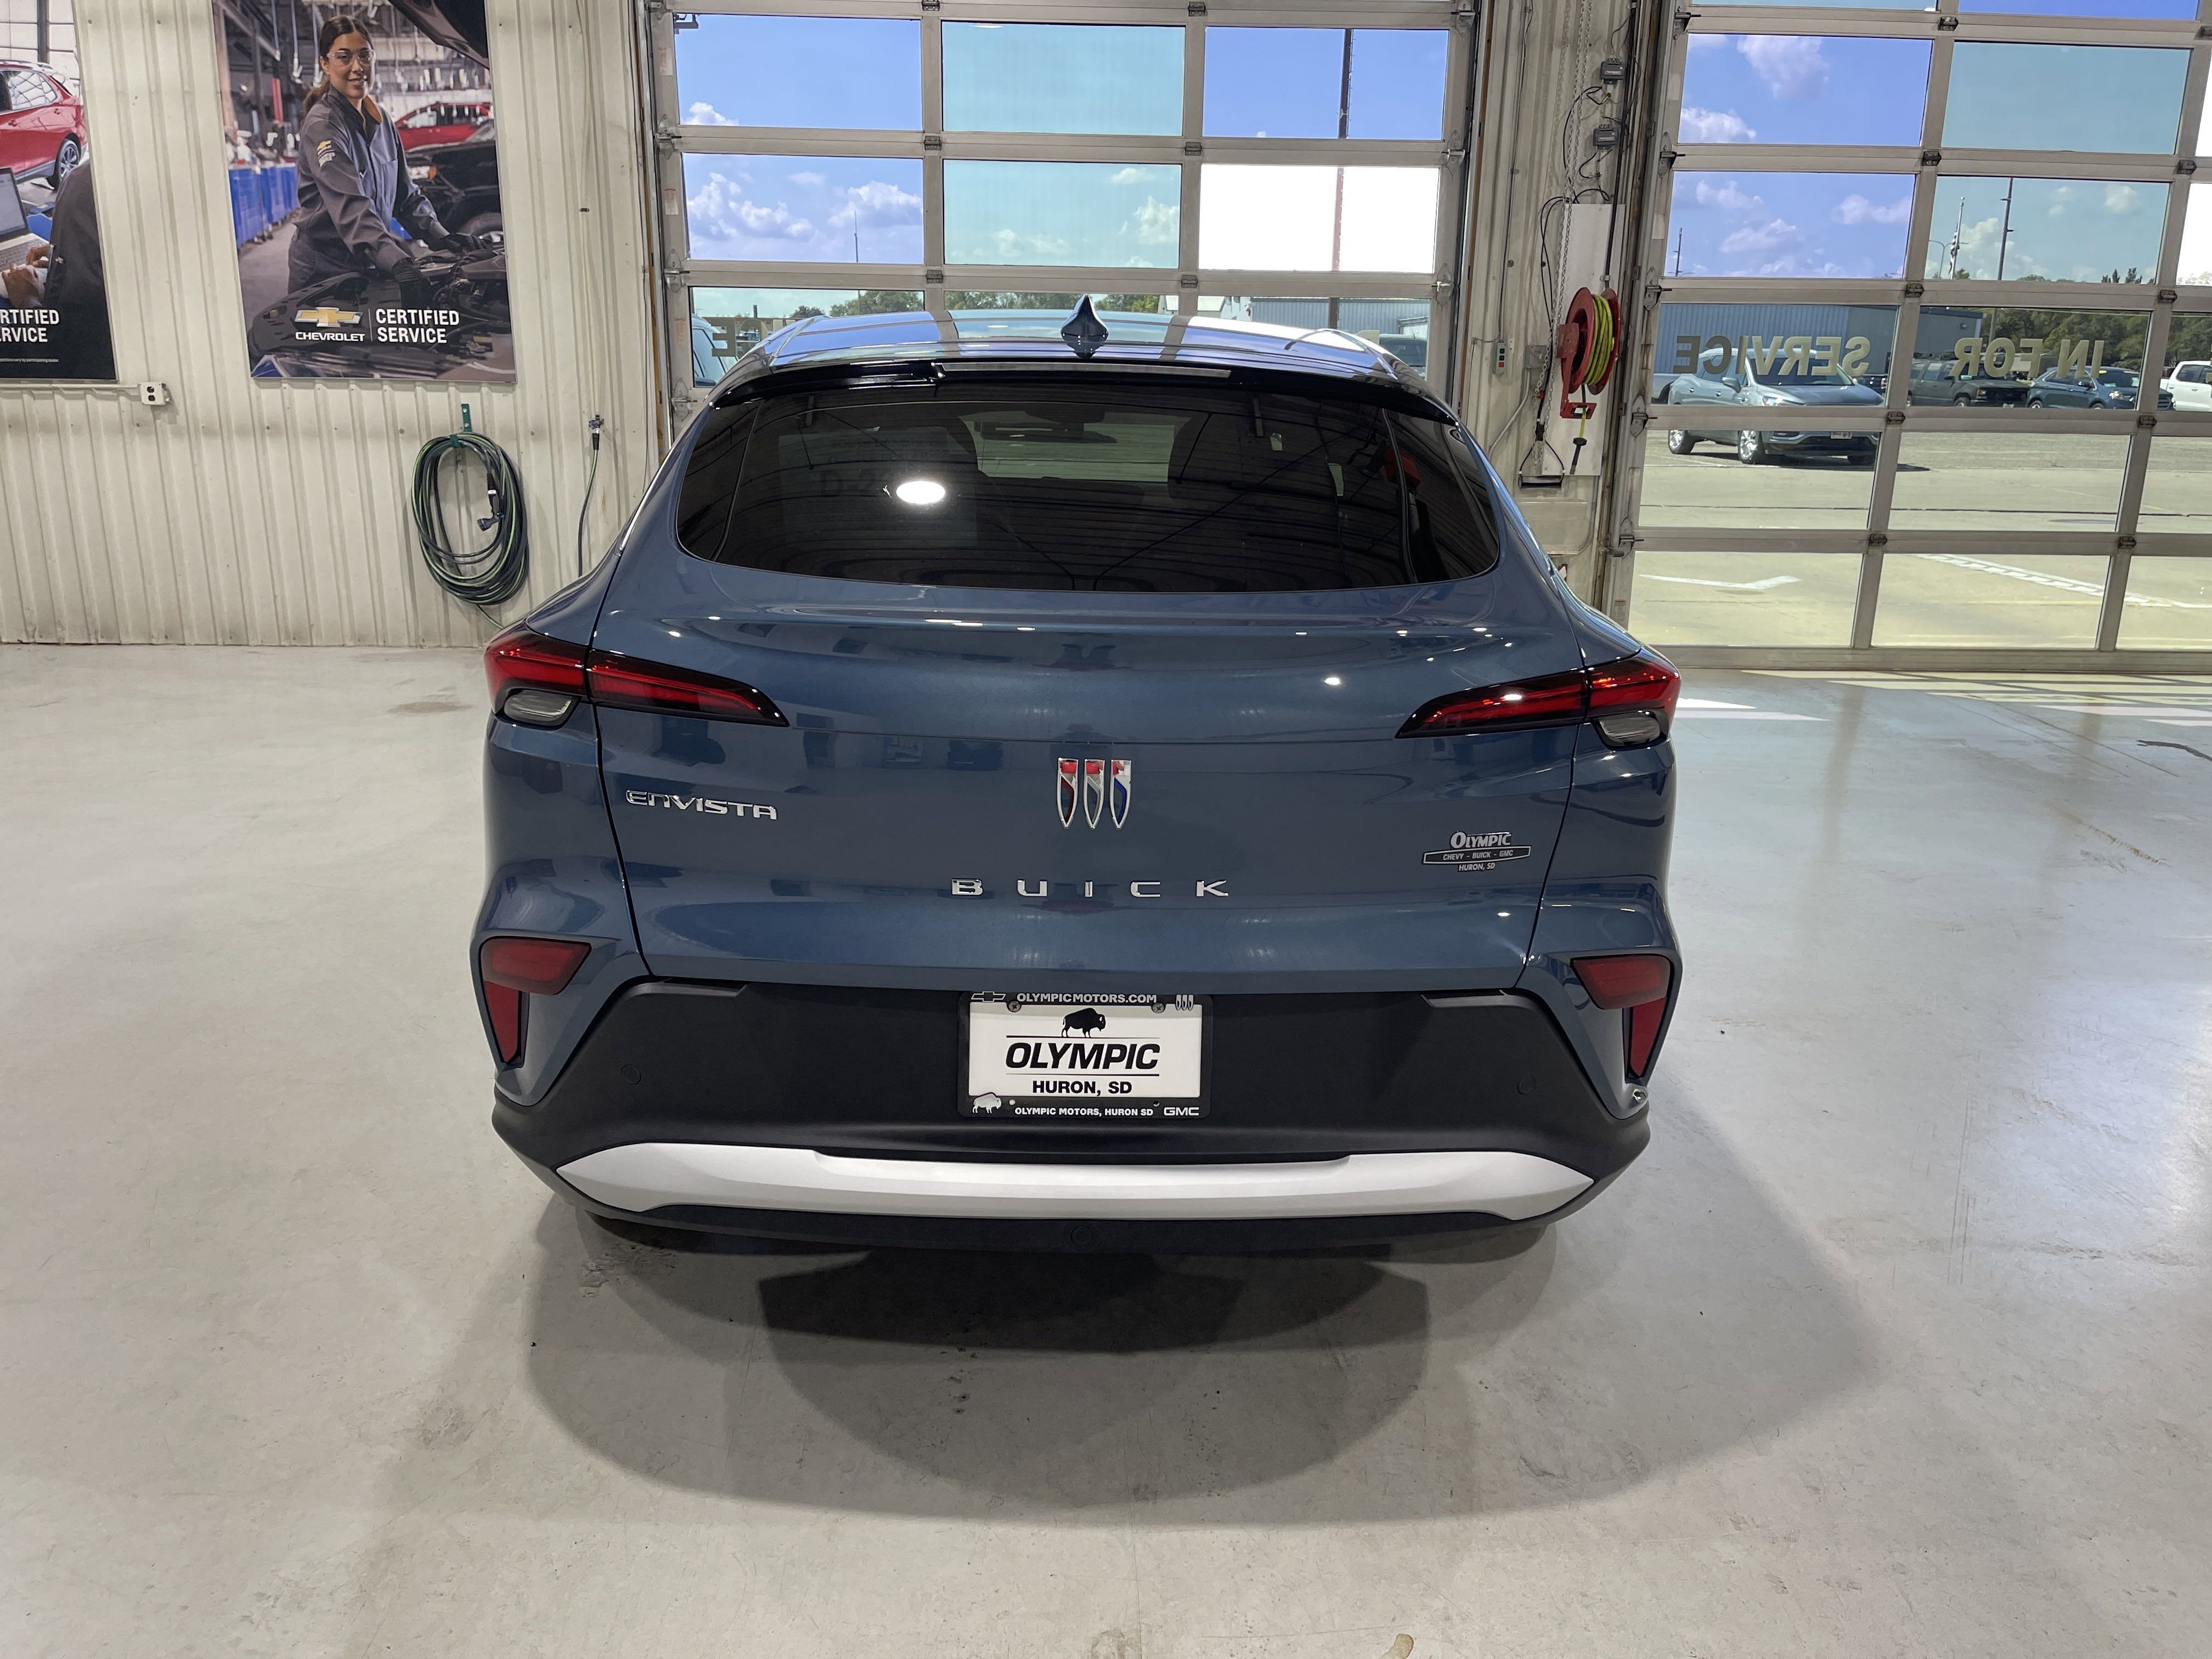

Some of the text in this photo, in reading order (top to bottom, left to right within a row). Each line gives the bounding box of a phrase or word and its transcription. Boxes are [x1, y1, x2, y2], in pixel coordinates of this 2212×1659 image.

[0, 309, 60, 325] RTIFIED
[375, 308, 460, 325] CERTIFIED
[0, 328, 48, 342] RVICE
[295, 331, 365, 342] CHEVROLET
[377, 327, 447, 343] SERVICE
[626, 790, 777, 820] ENVISTA
[1450, 831, 1511, 849] OLYMPIC
[1443, 853, 1464, 861] CHEVY
[952, 878, 1228, 898] BUICK
[1016, 992, 1157, 1003] OLYMPICMOTORS.COM
[1005, 1042, 1160, 1070] OLYMPIC
[1032, 1080, 1132, 1097] HURON, SD
[1014, 1107, 1154, 1117] OLYMPIC MOTORS, HURON SD
[1164, 1107, 1200, 1116] GMC
